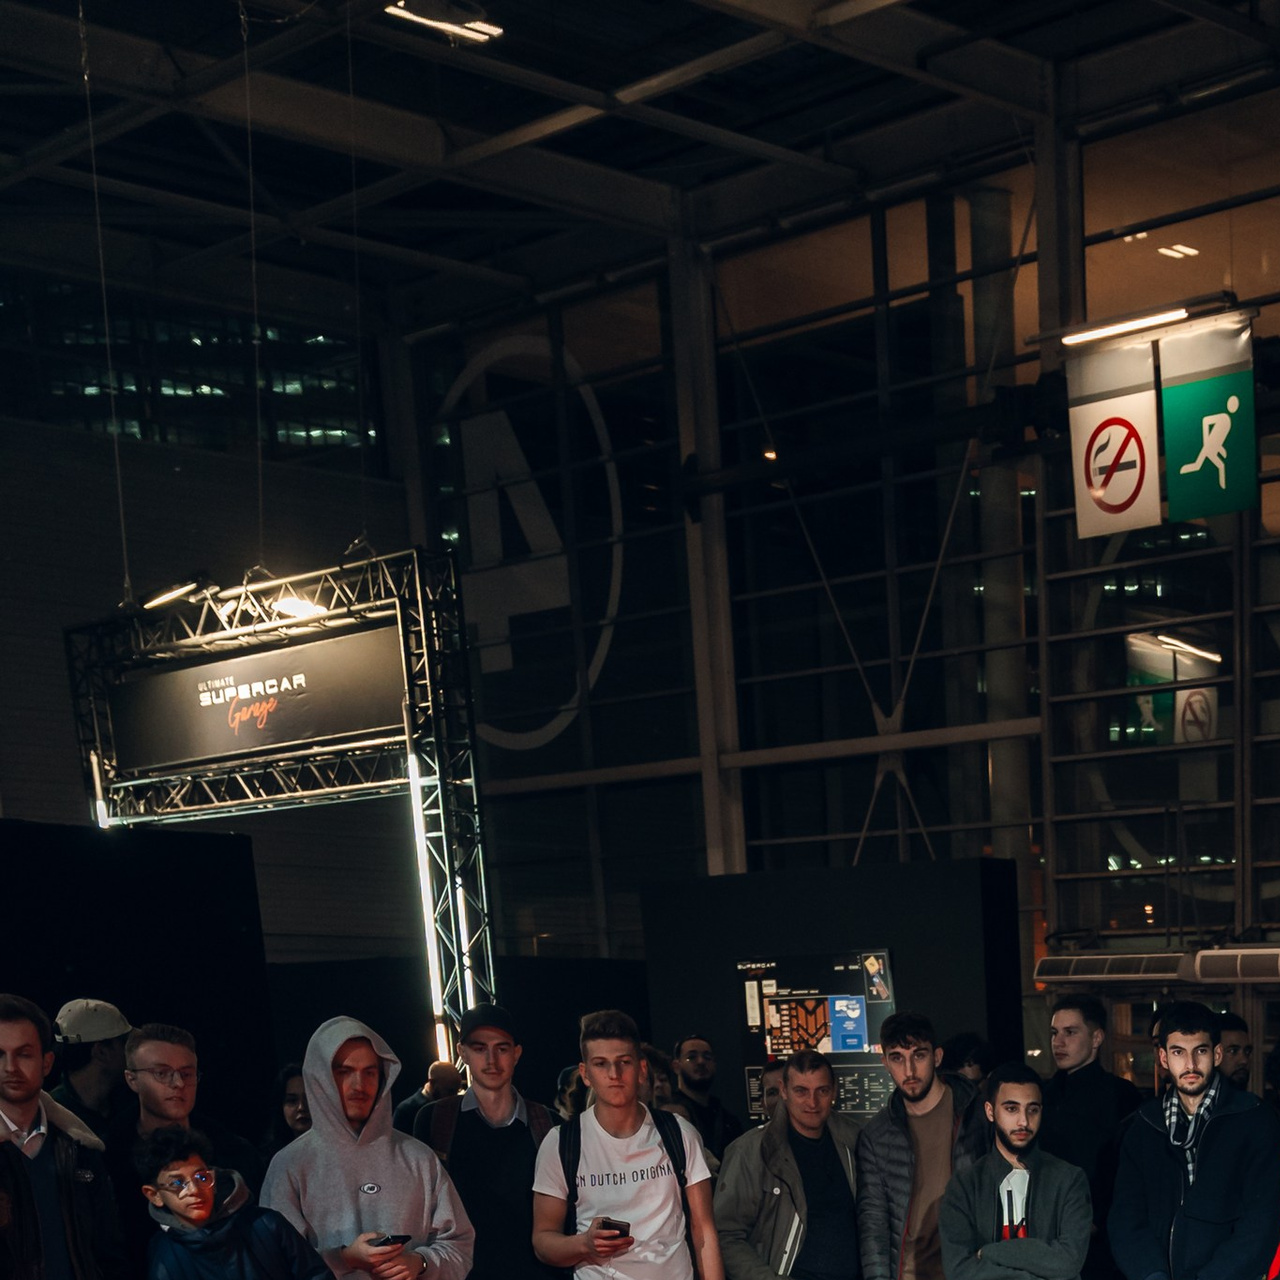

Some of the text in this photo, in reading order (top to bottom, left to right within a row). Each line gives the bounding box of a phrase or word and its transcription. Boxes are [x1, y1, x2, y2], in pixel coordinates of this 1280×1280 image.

[197, 676, 235, 691] ULTIMATE
[199, 673, 307, 707] SUPERCAR
[228, 695, 278, 736] Garage
[590, 1172, 627, 1187] DUTCH
[632, 1162, 673, 1183] ORIGINA
